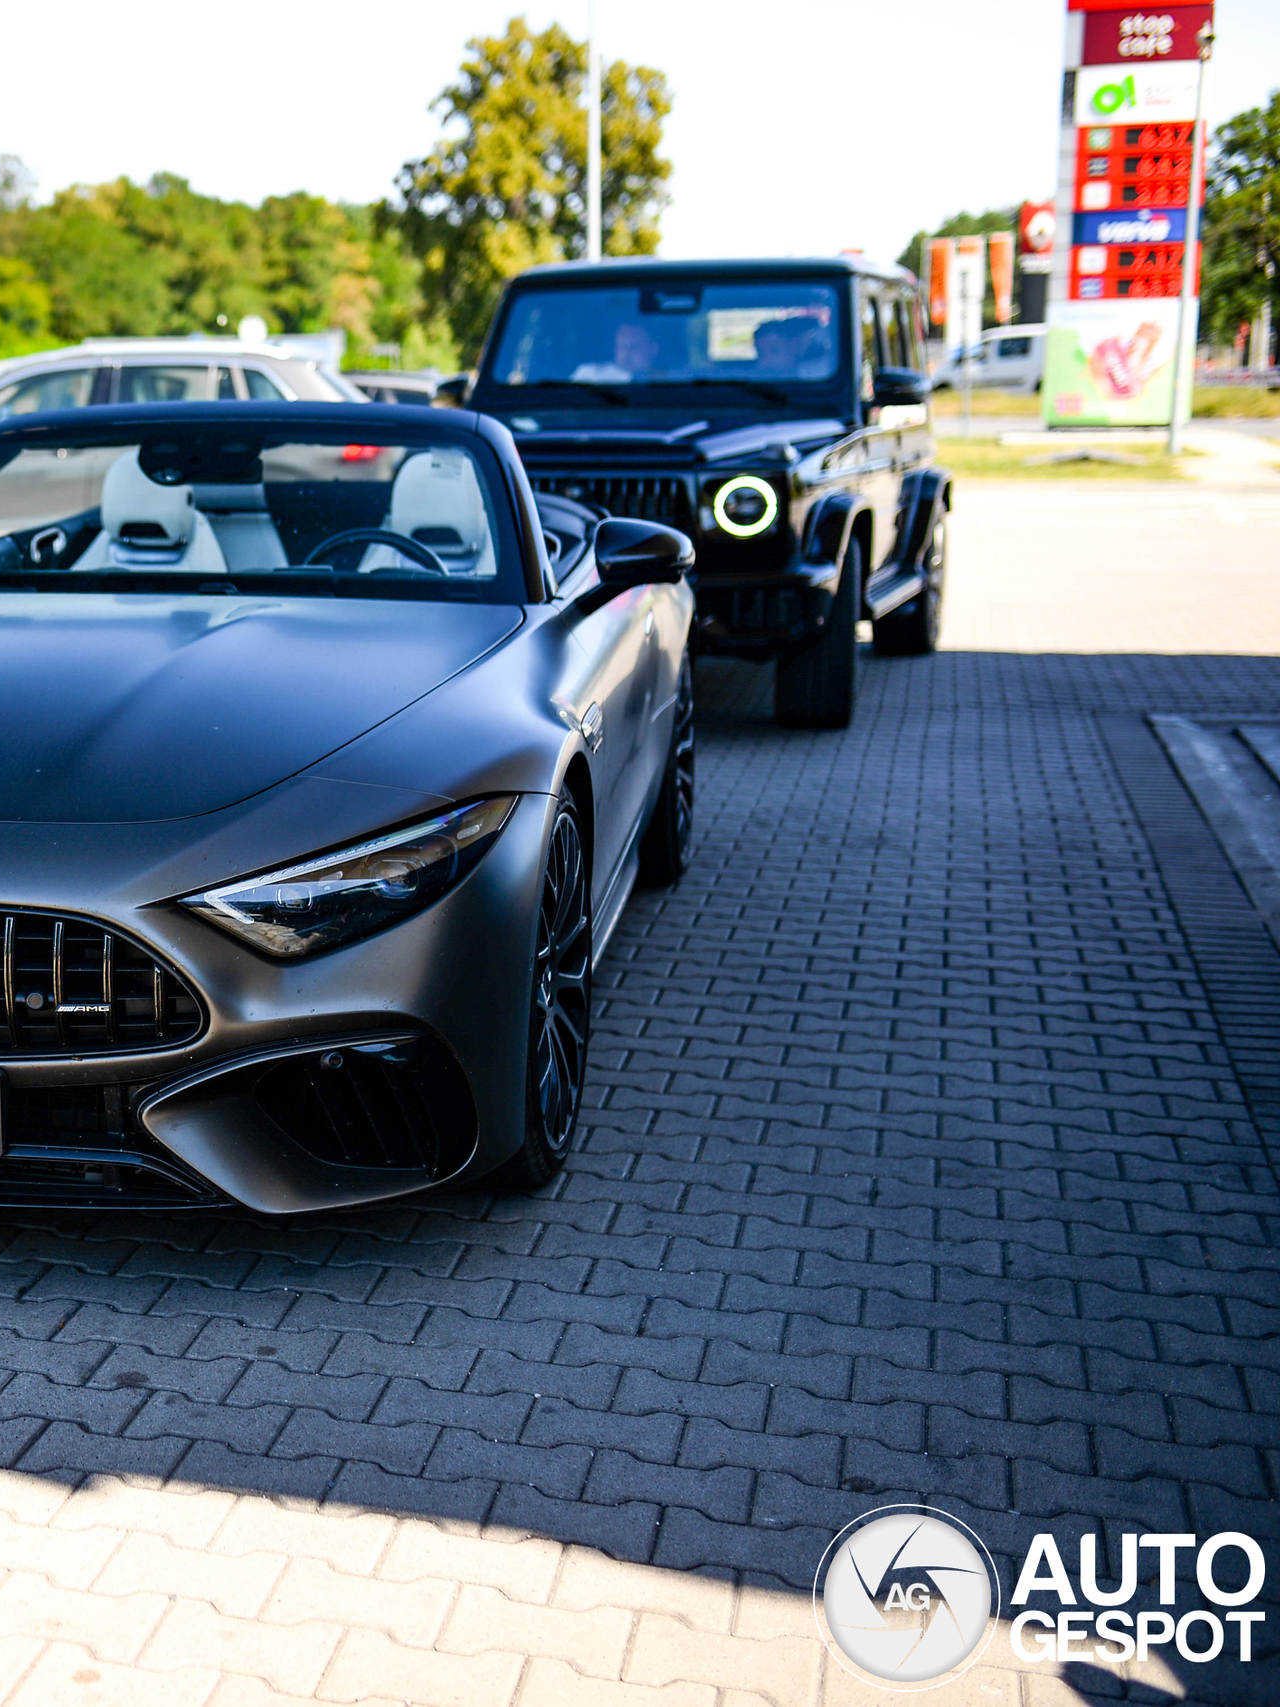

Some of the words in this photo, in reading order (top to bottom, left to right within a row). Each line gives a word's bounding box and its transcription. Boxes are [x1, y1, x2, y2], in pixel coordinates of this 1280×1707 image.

[1119, 12, 1175, 37] stop
[1117, 34, 1174, 58] cafe
[1097, 219, 1171, 244] verva
